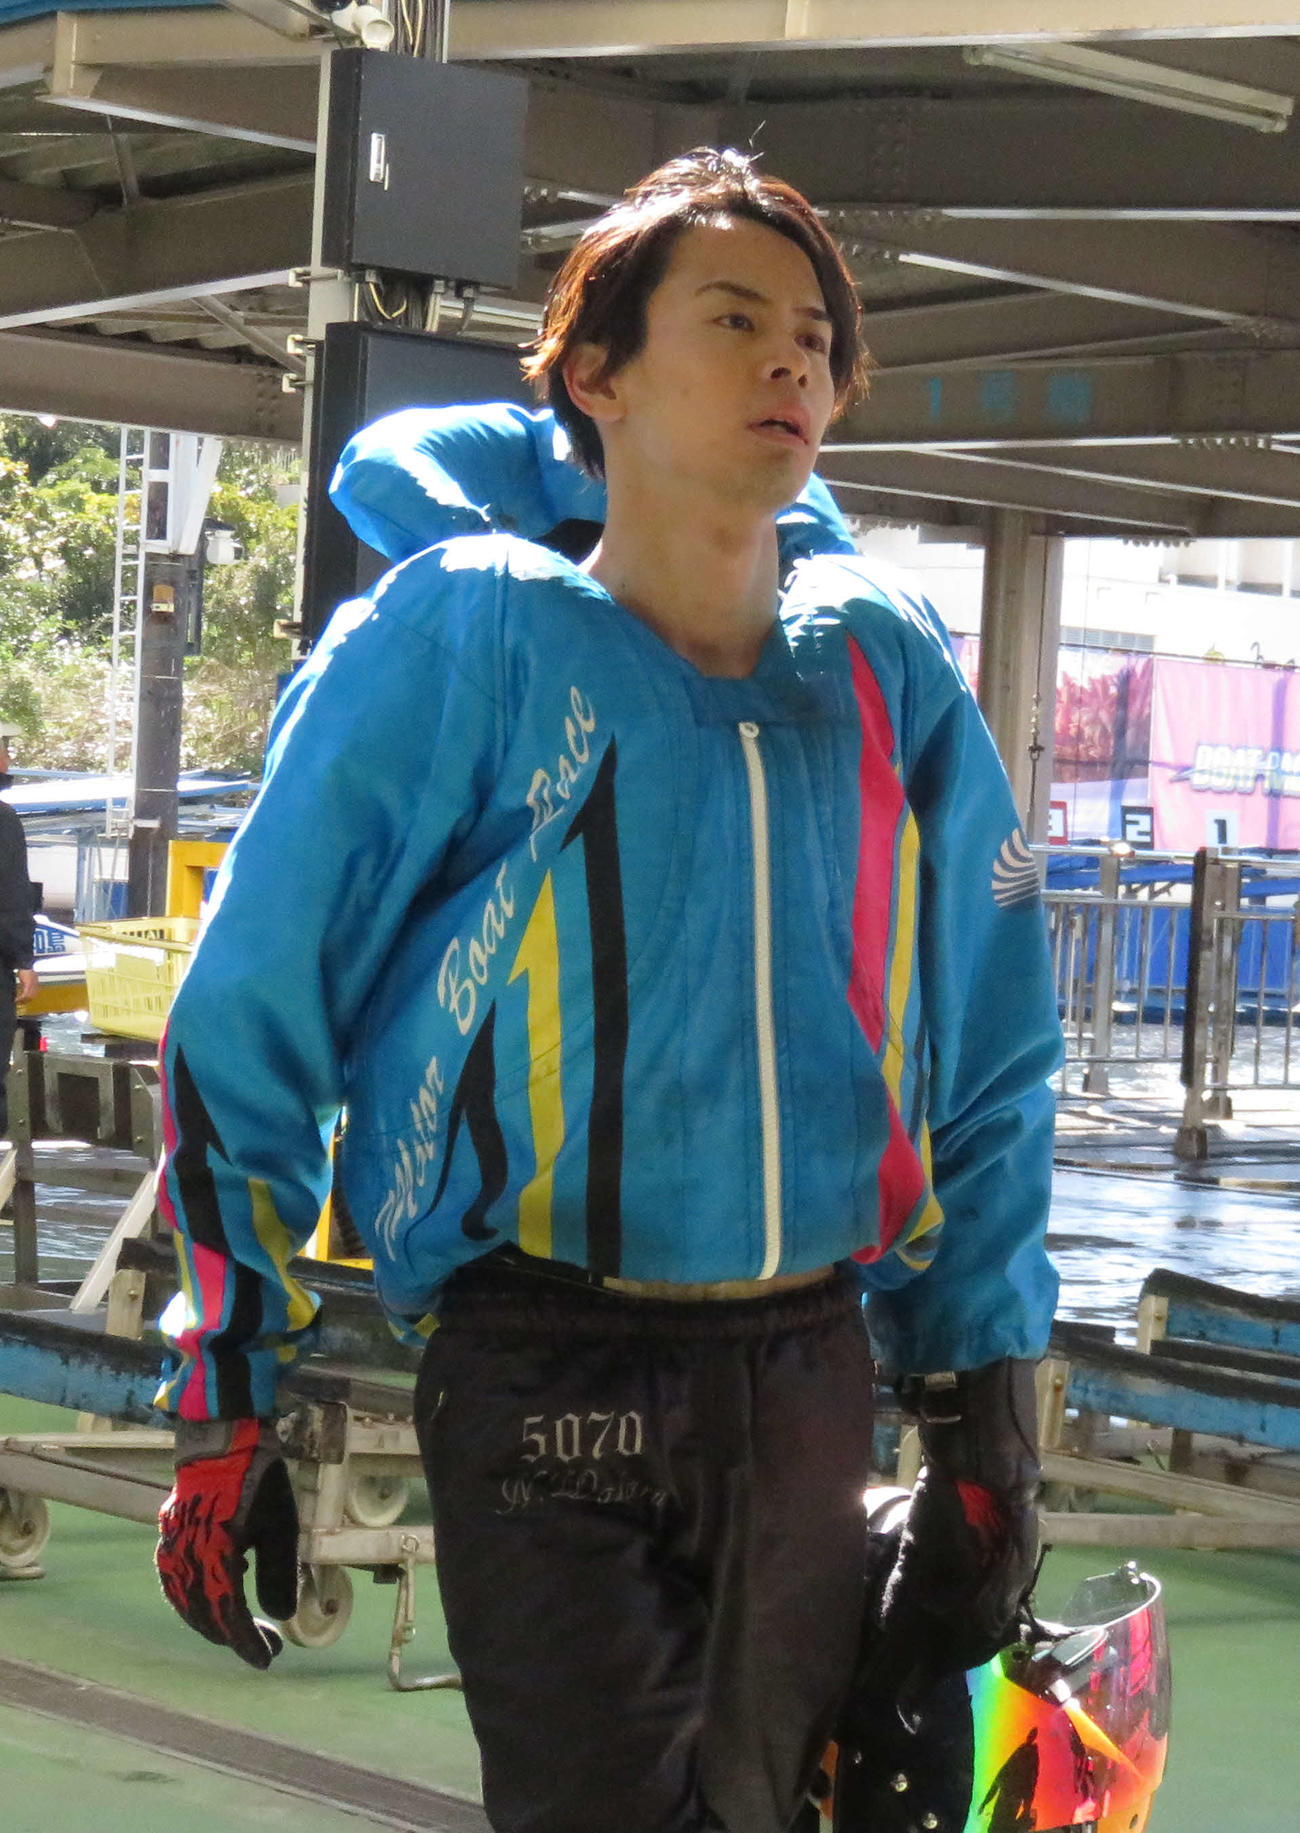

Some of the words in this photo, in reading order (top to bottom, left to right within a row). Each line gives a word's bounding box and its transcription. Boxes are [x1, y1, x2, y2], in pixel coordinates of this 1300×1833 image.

[1124, 812, 1152, 841] 2
[1213, 818, 1227, 845] 1
[437, 861, 514, 1035] Boat
[526, 685, 595, 862] Race
[520, 1410, 644, 1464] 5070
